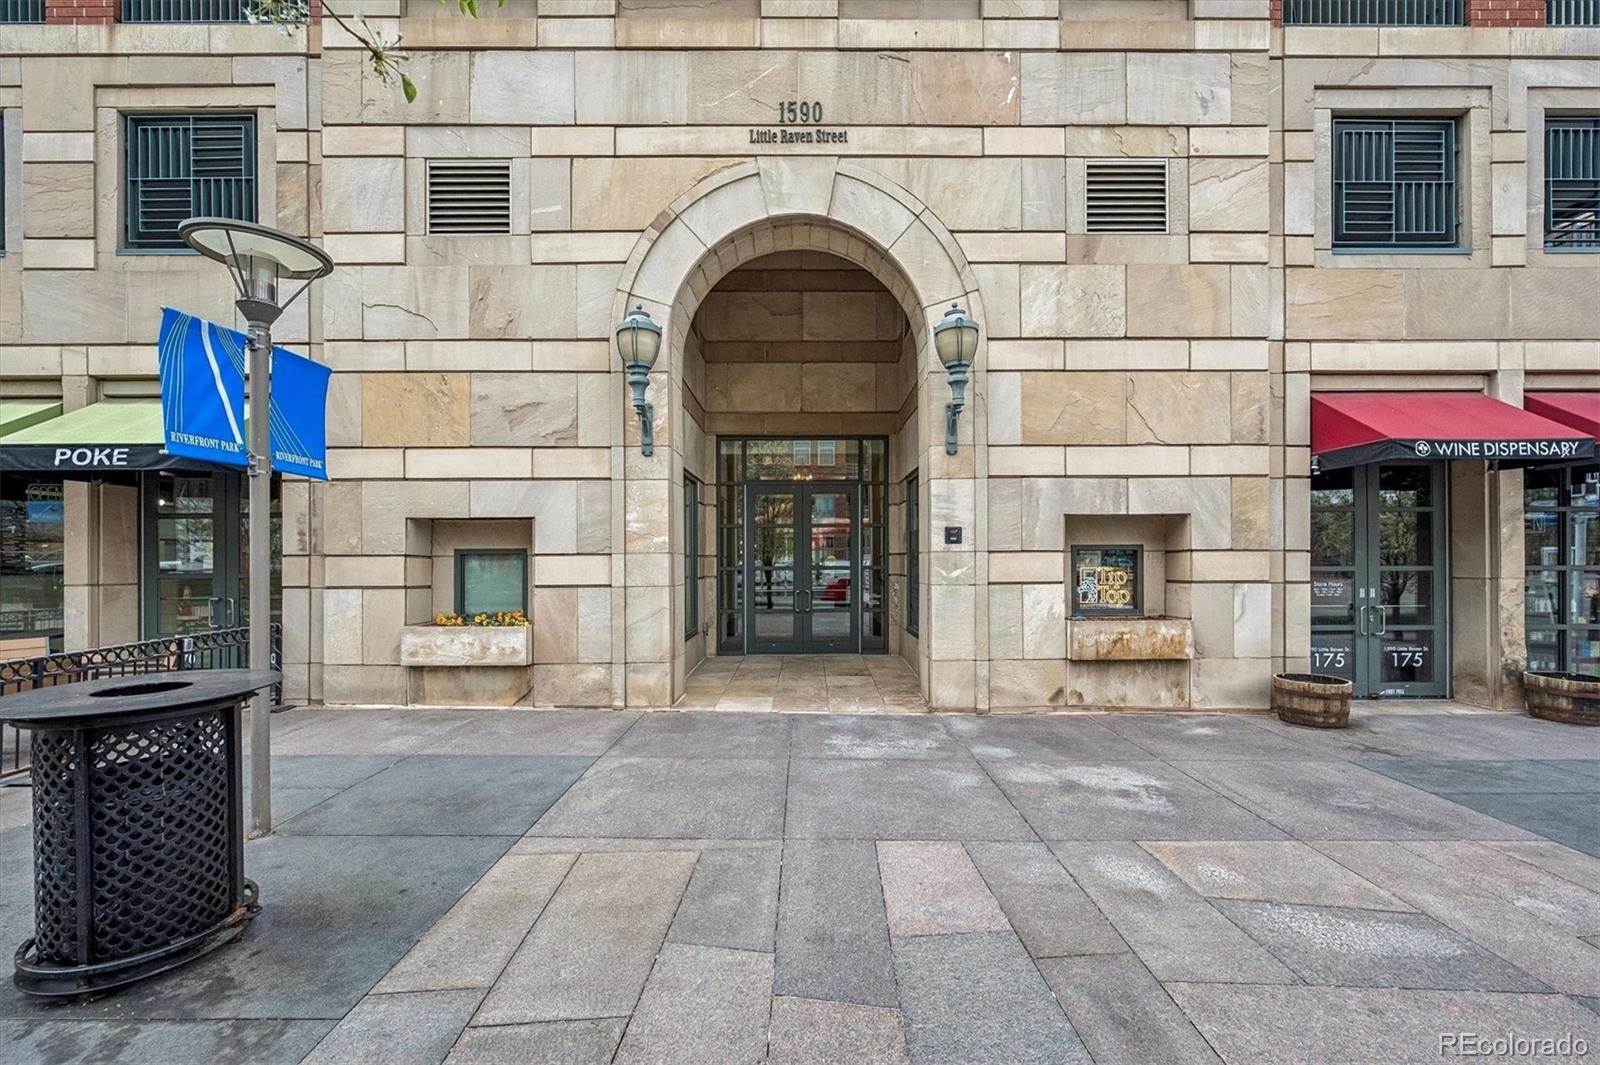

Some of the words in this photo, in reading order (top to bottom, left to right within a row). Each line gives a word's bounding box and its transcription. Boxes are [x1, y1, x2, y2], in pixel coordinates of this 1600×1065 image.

[779, 101, 823, 123] 1590
[749, 129, 778, 144] Little
[780, 129, 813, 144] Raven
[815, 129, 848, 144] Street
[170, 431, 219, 450] RIVERFRONT
[220, 441, 240, 453] PARK
[1434, 442, 1480, 457] WINE
[1484, 441, 1579, 458] DISPENSARY
[54, 447, 129, 466] POKE
[275, 450, 309, 466] RIVERFRONT
[309, 458, 322, 469] PARK
[1096, 566, 1128, 590] Tip
[1096, 585, 1131, 608] Top
[1314, 653, 1345, 667] 175
[1392, 652, 1423, 667] 175
